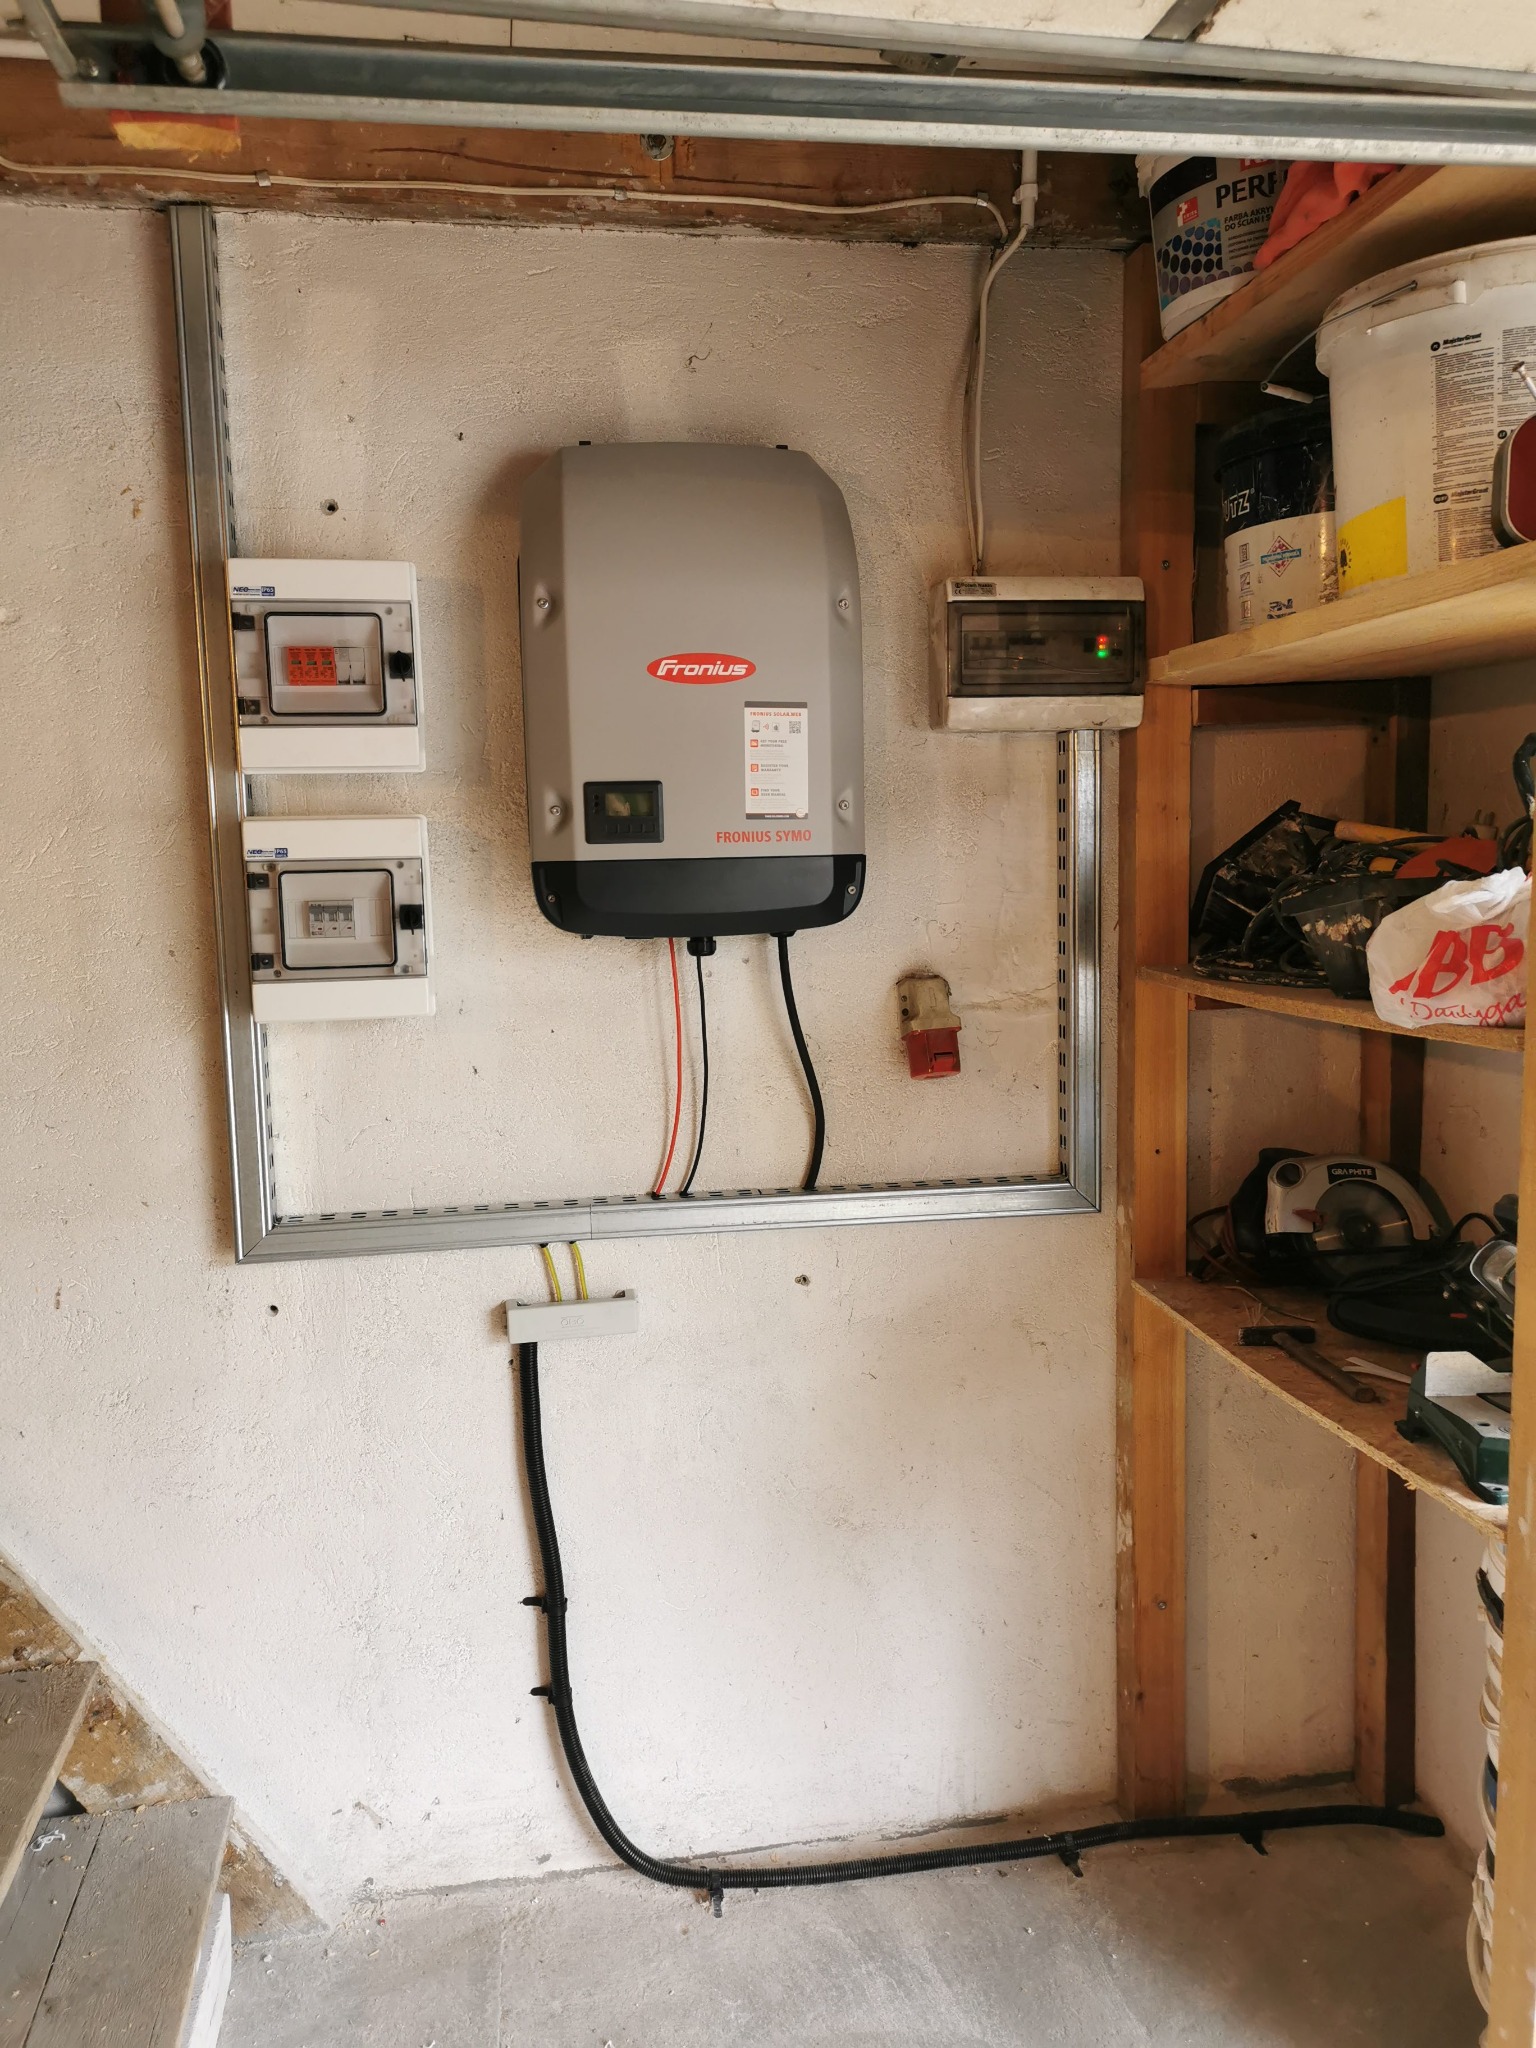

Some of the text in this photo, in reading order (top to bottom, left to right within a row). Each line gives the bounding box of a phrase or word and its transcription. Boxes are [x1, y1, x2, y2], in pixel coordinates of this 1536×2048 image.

[1224, 211, 1249, 224] FARBA
[1224, 222, 1236, 232] DO
[656, 659, 749, 677] Fronius
[716, 829, 812, 844] FRONIUS SYMO
[1331, 1168, 1373, 1176] GRAPHITE
